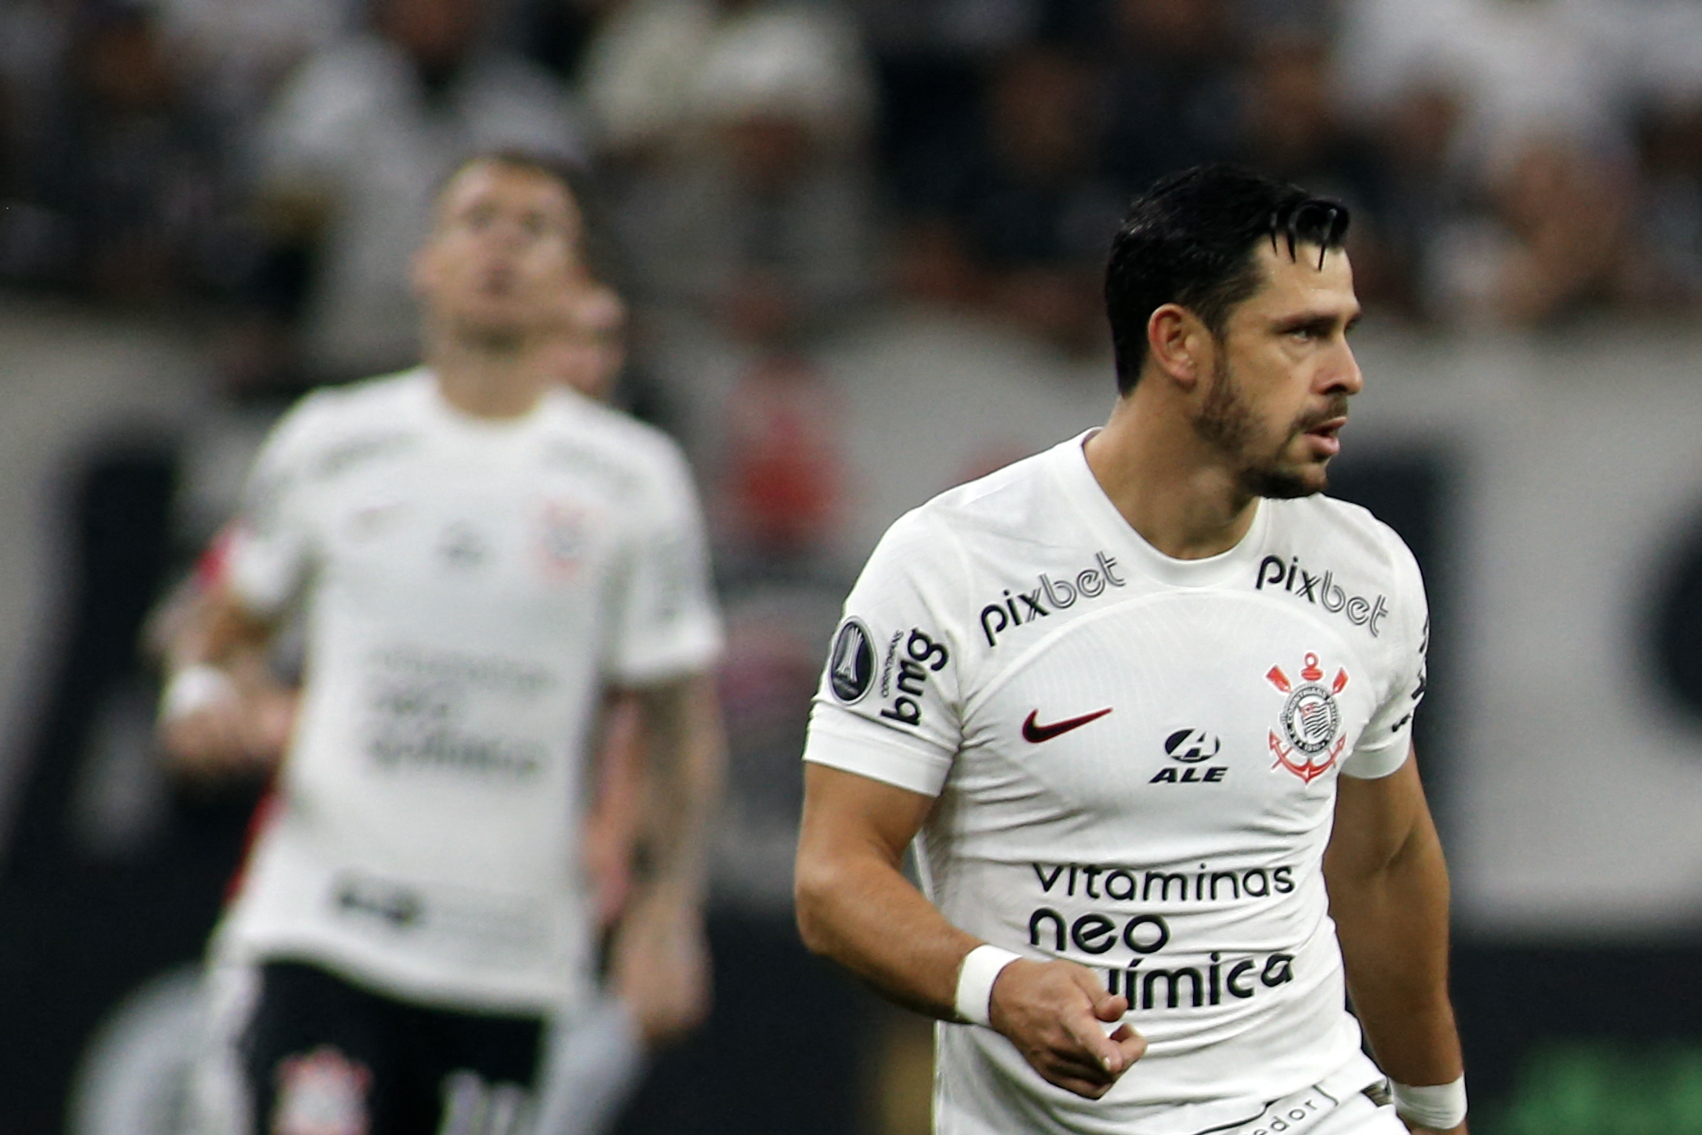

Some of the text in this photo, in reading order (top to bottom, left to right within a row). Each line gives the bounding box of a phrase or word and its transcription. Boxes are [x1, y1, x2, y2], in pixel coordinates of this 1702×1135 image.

[981, 550, 1127, 648] pixbet
[1256, 555, 1389, 637] pixbet
[881, 627, 950, 726] bmg
[1147, 766, 1229, 784] ALE
[1032, 862, 1296, 901] vitaminas
[1029, 908, 1170, 954] neo
